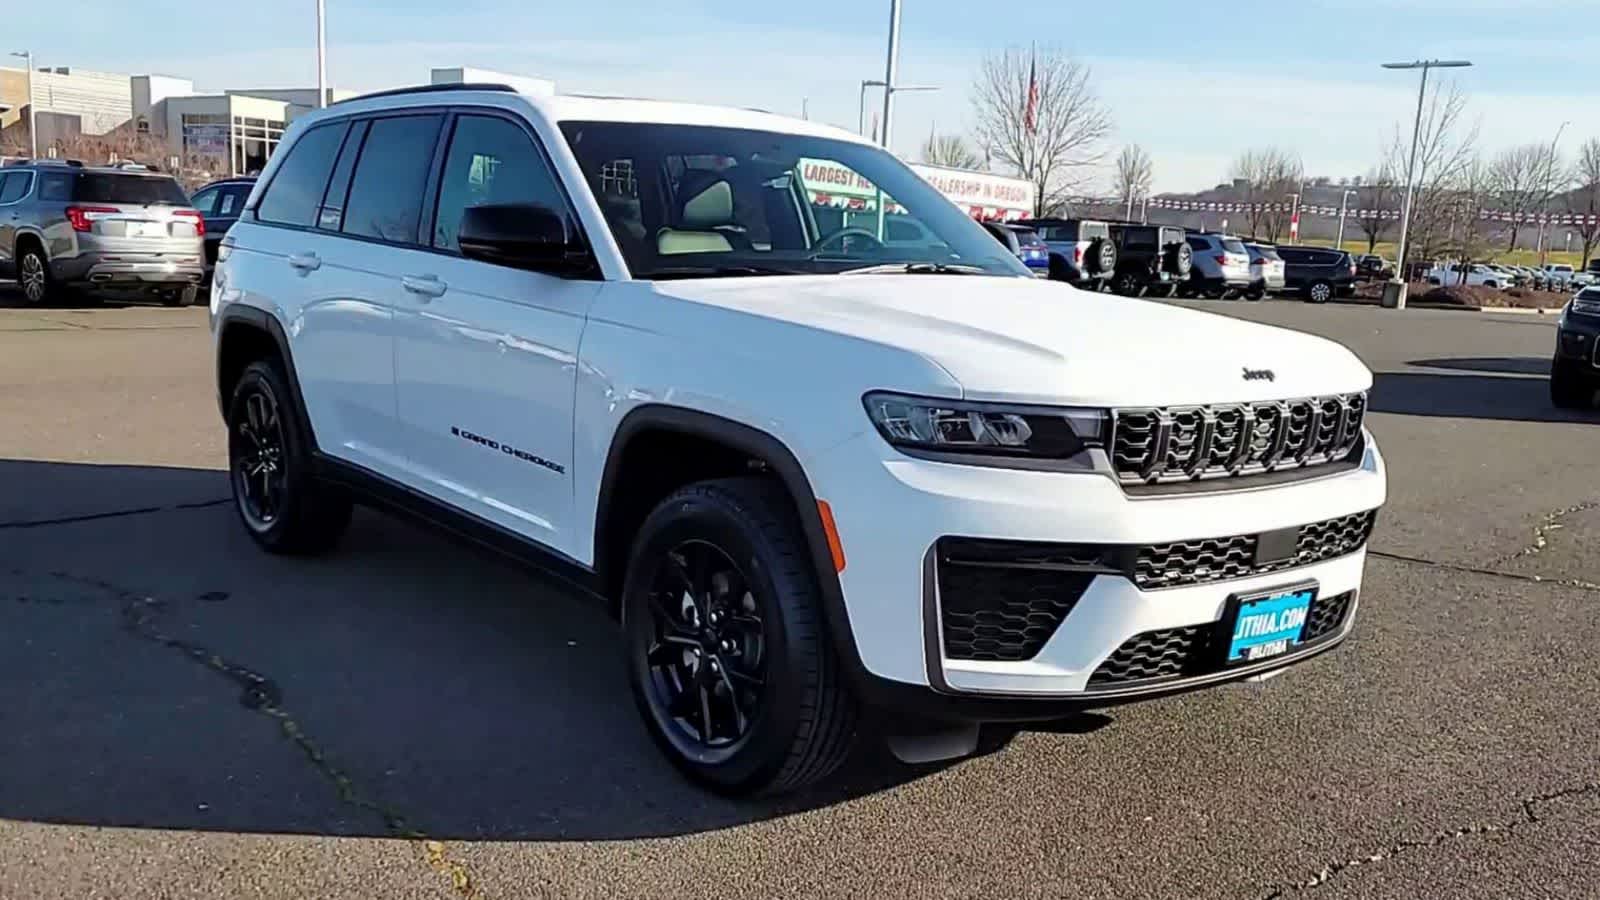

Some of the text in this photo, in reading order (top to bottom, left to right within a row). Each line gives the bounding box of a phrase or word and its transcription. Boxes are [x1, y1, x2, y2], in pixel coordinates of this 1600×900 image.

[804, 164, 856, 187] LARGEST
[1242, 367, 1275, 382] Jeep
[461, 430, 565, 474] GRAND CHEROKEE
